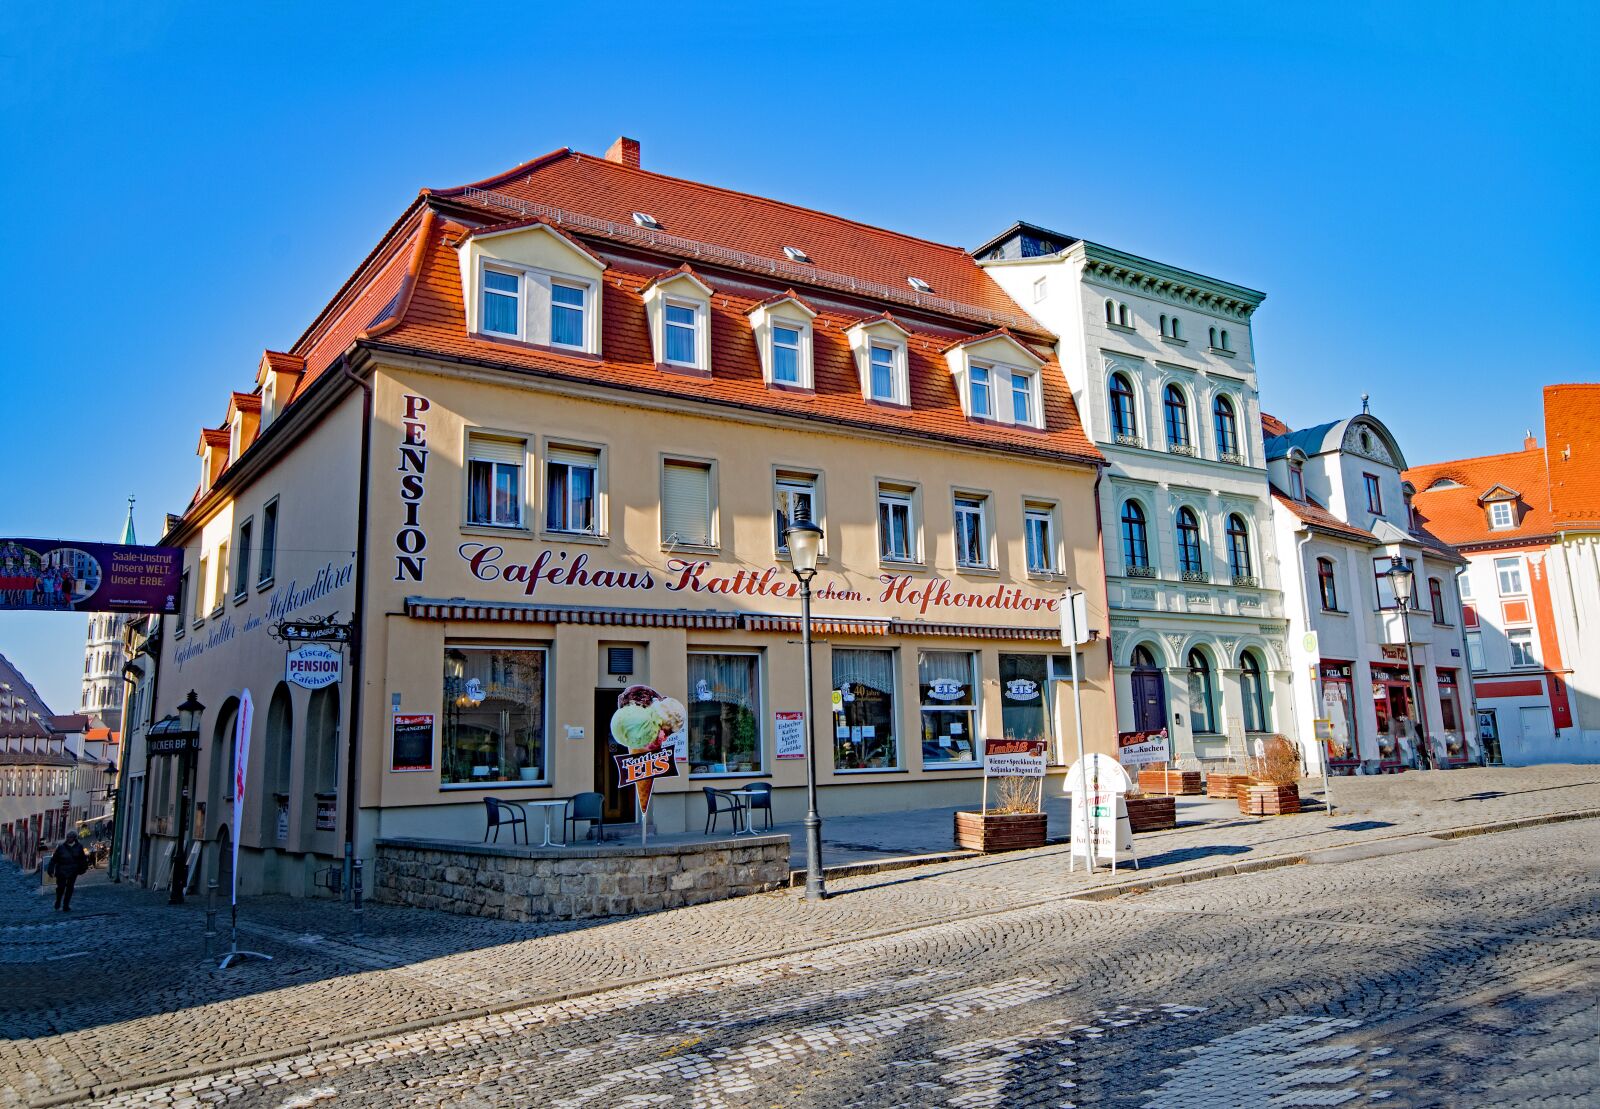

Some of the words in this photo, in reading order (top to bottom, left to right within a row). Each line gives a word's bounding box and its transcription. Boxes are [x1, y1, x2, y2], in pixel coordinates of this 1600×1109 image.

[395, 395, 430, 582] PENSION
[112, 551, 173, 564] Saale-Unstrut
[111, 562, 144, 573] Unsere
[145, 564, 171, 575] WELT.
[110, 574, 138, 585] Unser
[140, 576, 166, 587] ERBE.
[665, 558, 801, 598] Kattler
[879, 574, 1067, 615] Hofkonditore
[299, 649, 332, 660] Eiscafé
[290, 660, 339, 673] PENSION
[1326, 669, 1341, 677] PIZZA
[292, 672, 336, 685] Caféhaus
[617, 675, 627, 683] 40
[935, 684, 958, 695] EIS
[1011, 684, 1034, 695] EIS
[1122, 731, 1145, 746] Café
[1123, 746, 1133, 755] Eis
[1139, 744, 1164, 753] Kuchen
[622, 748, 673, 769] Kattler's
[989, 758, 1007, 766] Wiener
[626, 756, 671, 782] EIS
[1077, 793, 1111, 809] Zmmer
